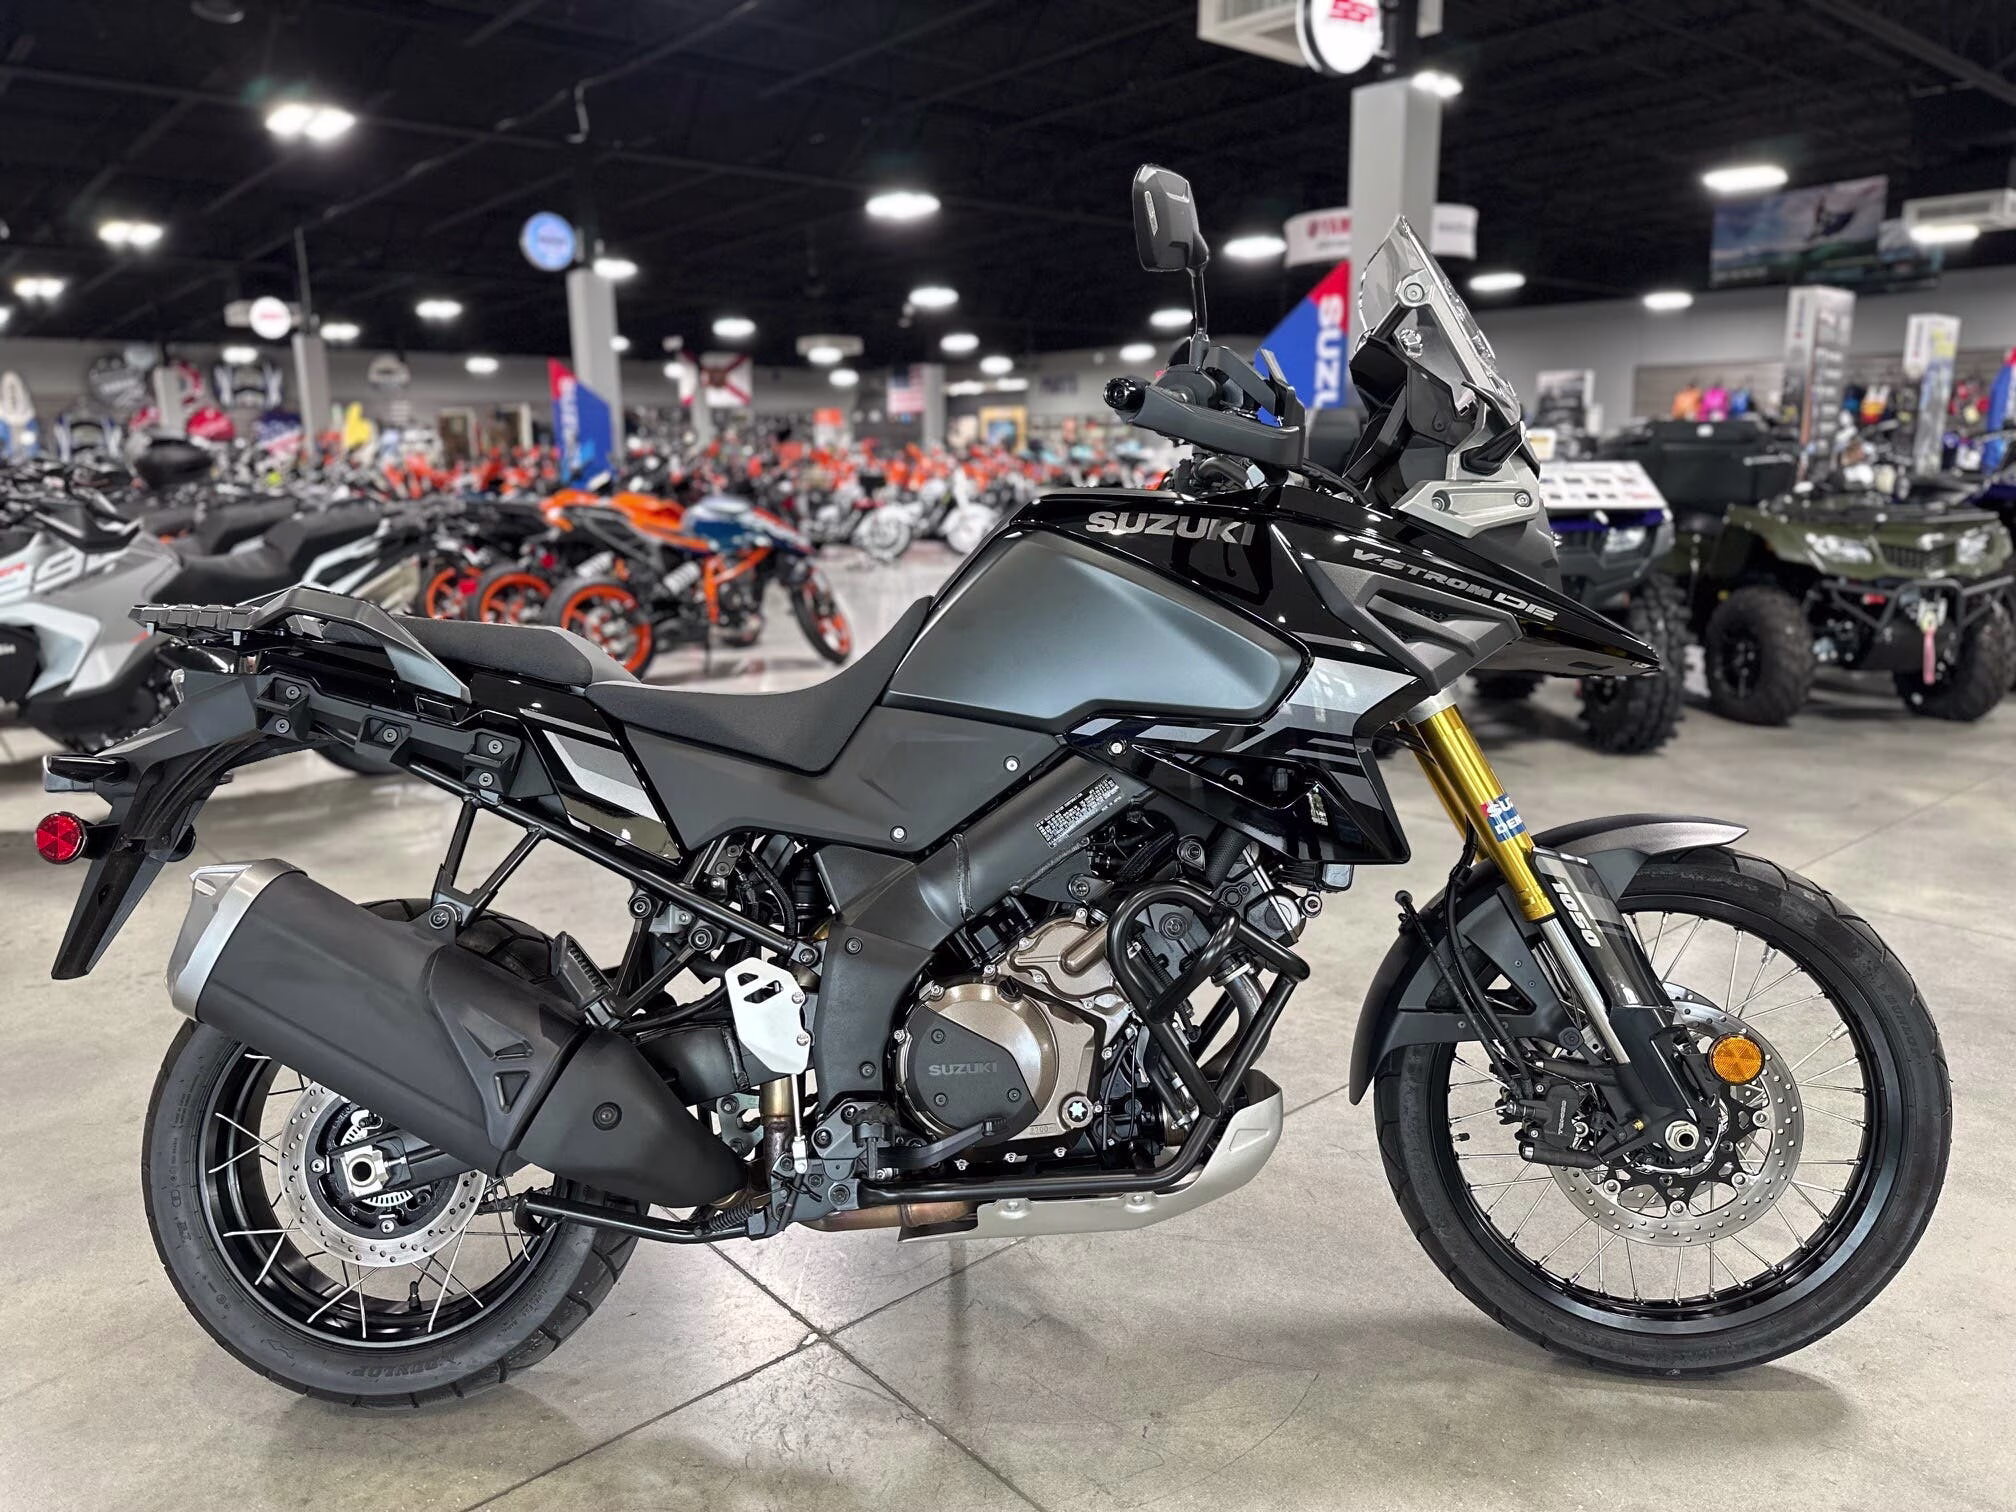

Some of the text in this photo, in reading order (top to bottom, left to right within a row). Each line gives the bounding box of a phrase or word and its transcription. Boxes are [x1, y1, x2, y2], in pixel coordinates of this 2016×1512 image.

[1085, 511, 1256, 546] SUZUKI
[1352, 548, 1558, 622] V-STROM DE
[1487, 796, 1514, 818] SU
[1551, 880, 1602, 948] 1050
[928, 1062, 998, 1076] SUZUKI
[350, 1357, 442, 1378] DUNLOP
